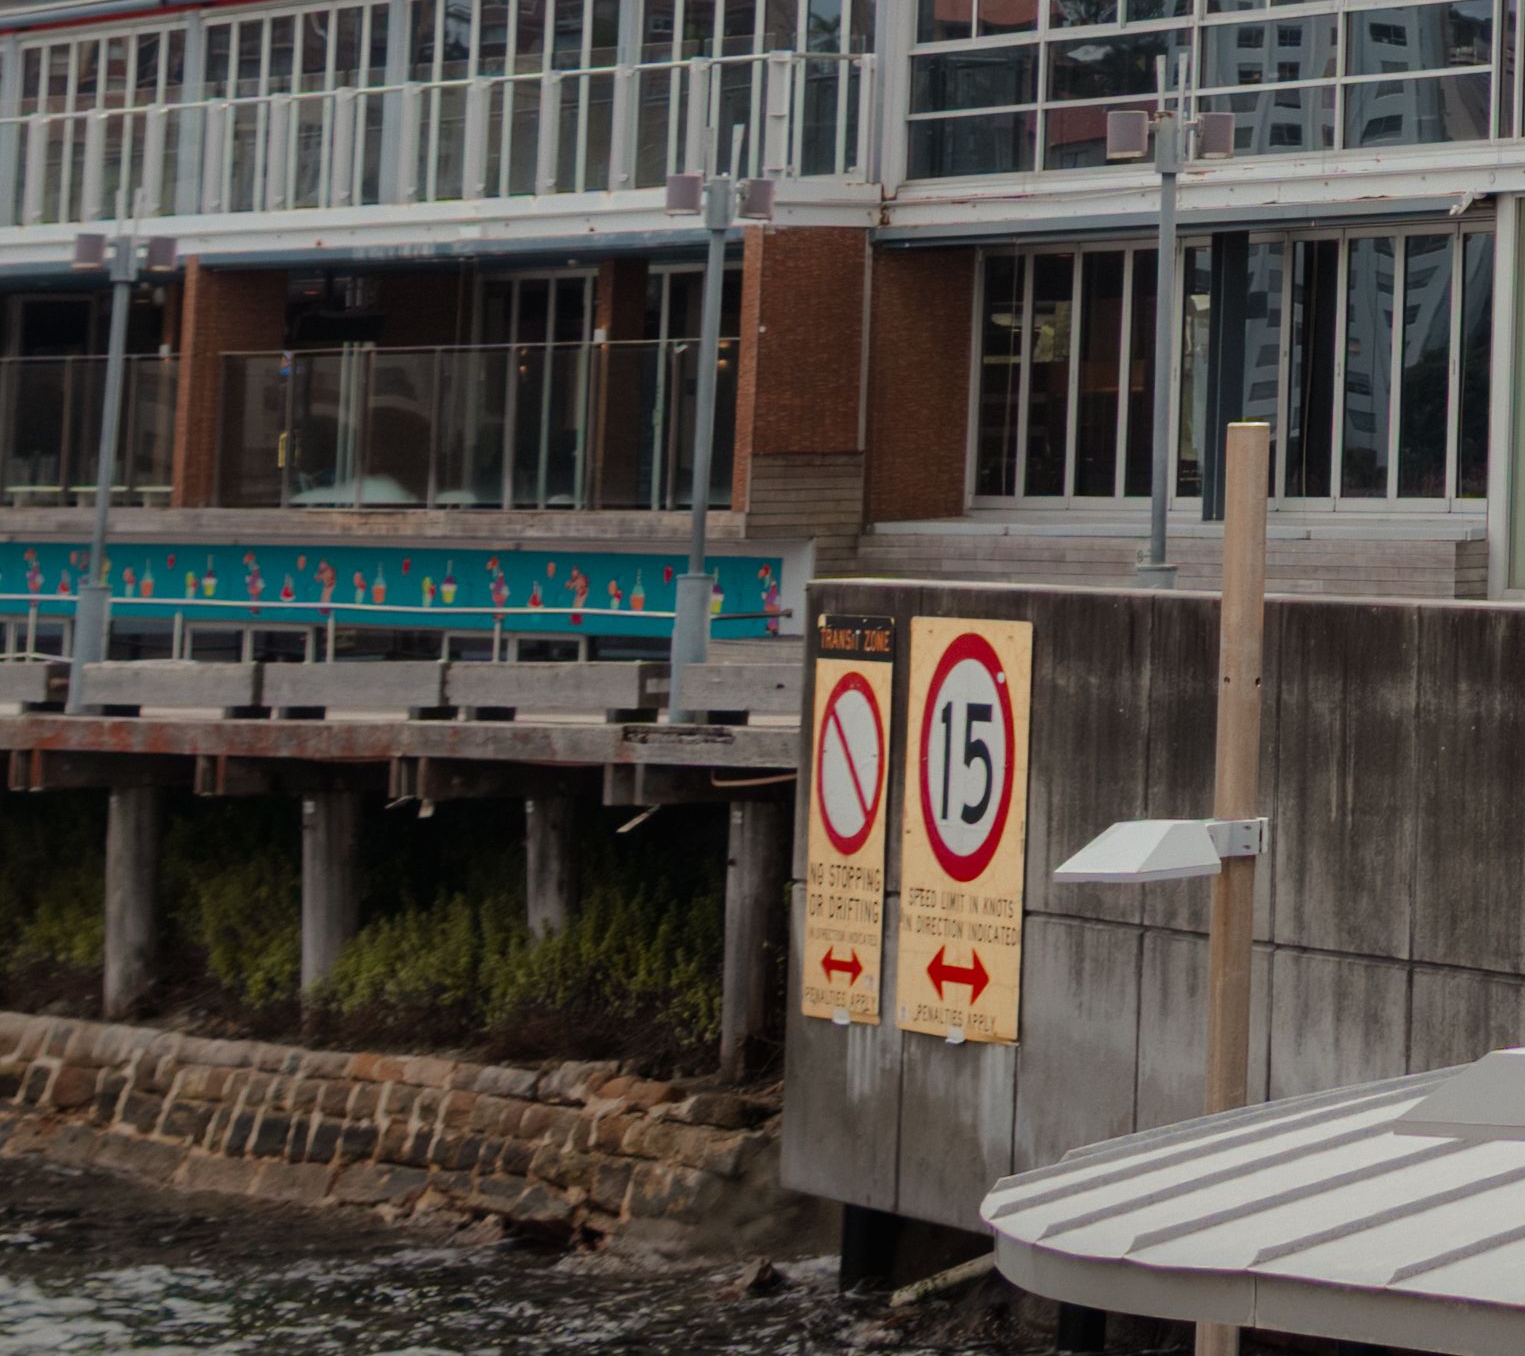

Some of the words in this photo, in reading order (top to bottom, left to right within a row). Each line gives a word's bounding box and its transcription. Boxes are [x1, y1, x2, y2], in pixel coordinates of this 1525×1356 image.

[820, 627, 859, 650] TRANSIT
[864, 630, 890, 652] ZONE
[941, 700, 993, 825] 15
[810, 862, 823, 886] NO
[830, 864, 881, 893] STOPPING
[810, 893, 823, 917] OR
[829, 895, 879, 924] DRIFTING
[909, 887, 936, 909] SPEED
[941, 890, 965, 912] LIMIT
[969, 894, 979, 914] IN
[983, 895, 1014, 918] KNOTS
[917, 915, 963, 938] DIRECTION
[968, 922, 1017, 947] INDICATED
[806, 987, 847, 1007] PENALTIES
[850, 990, 876, 1013] APPLY
[913, 1004, 962, 1027] PENALTIES
[967, 1014, 997, 1033] APPLY
